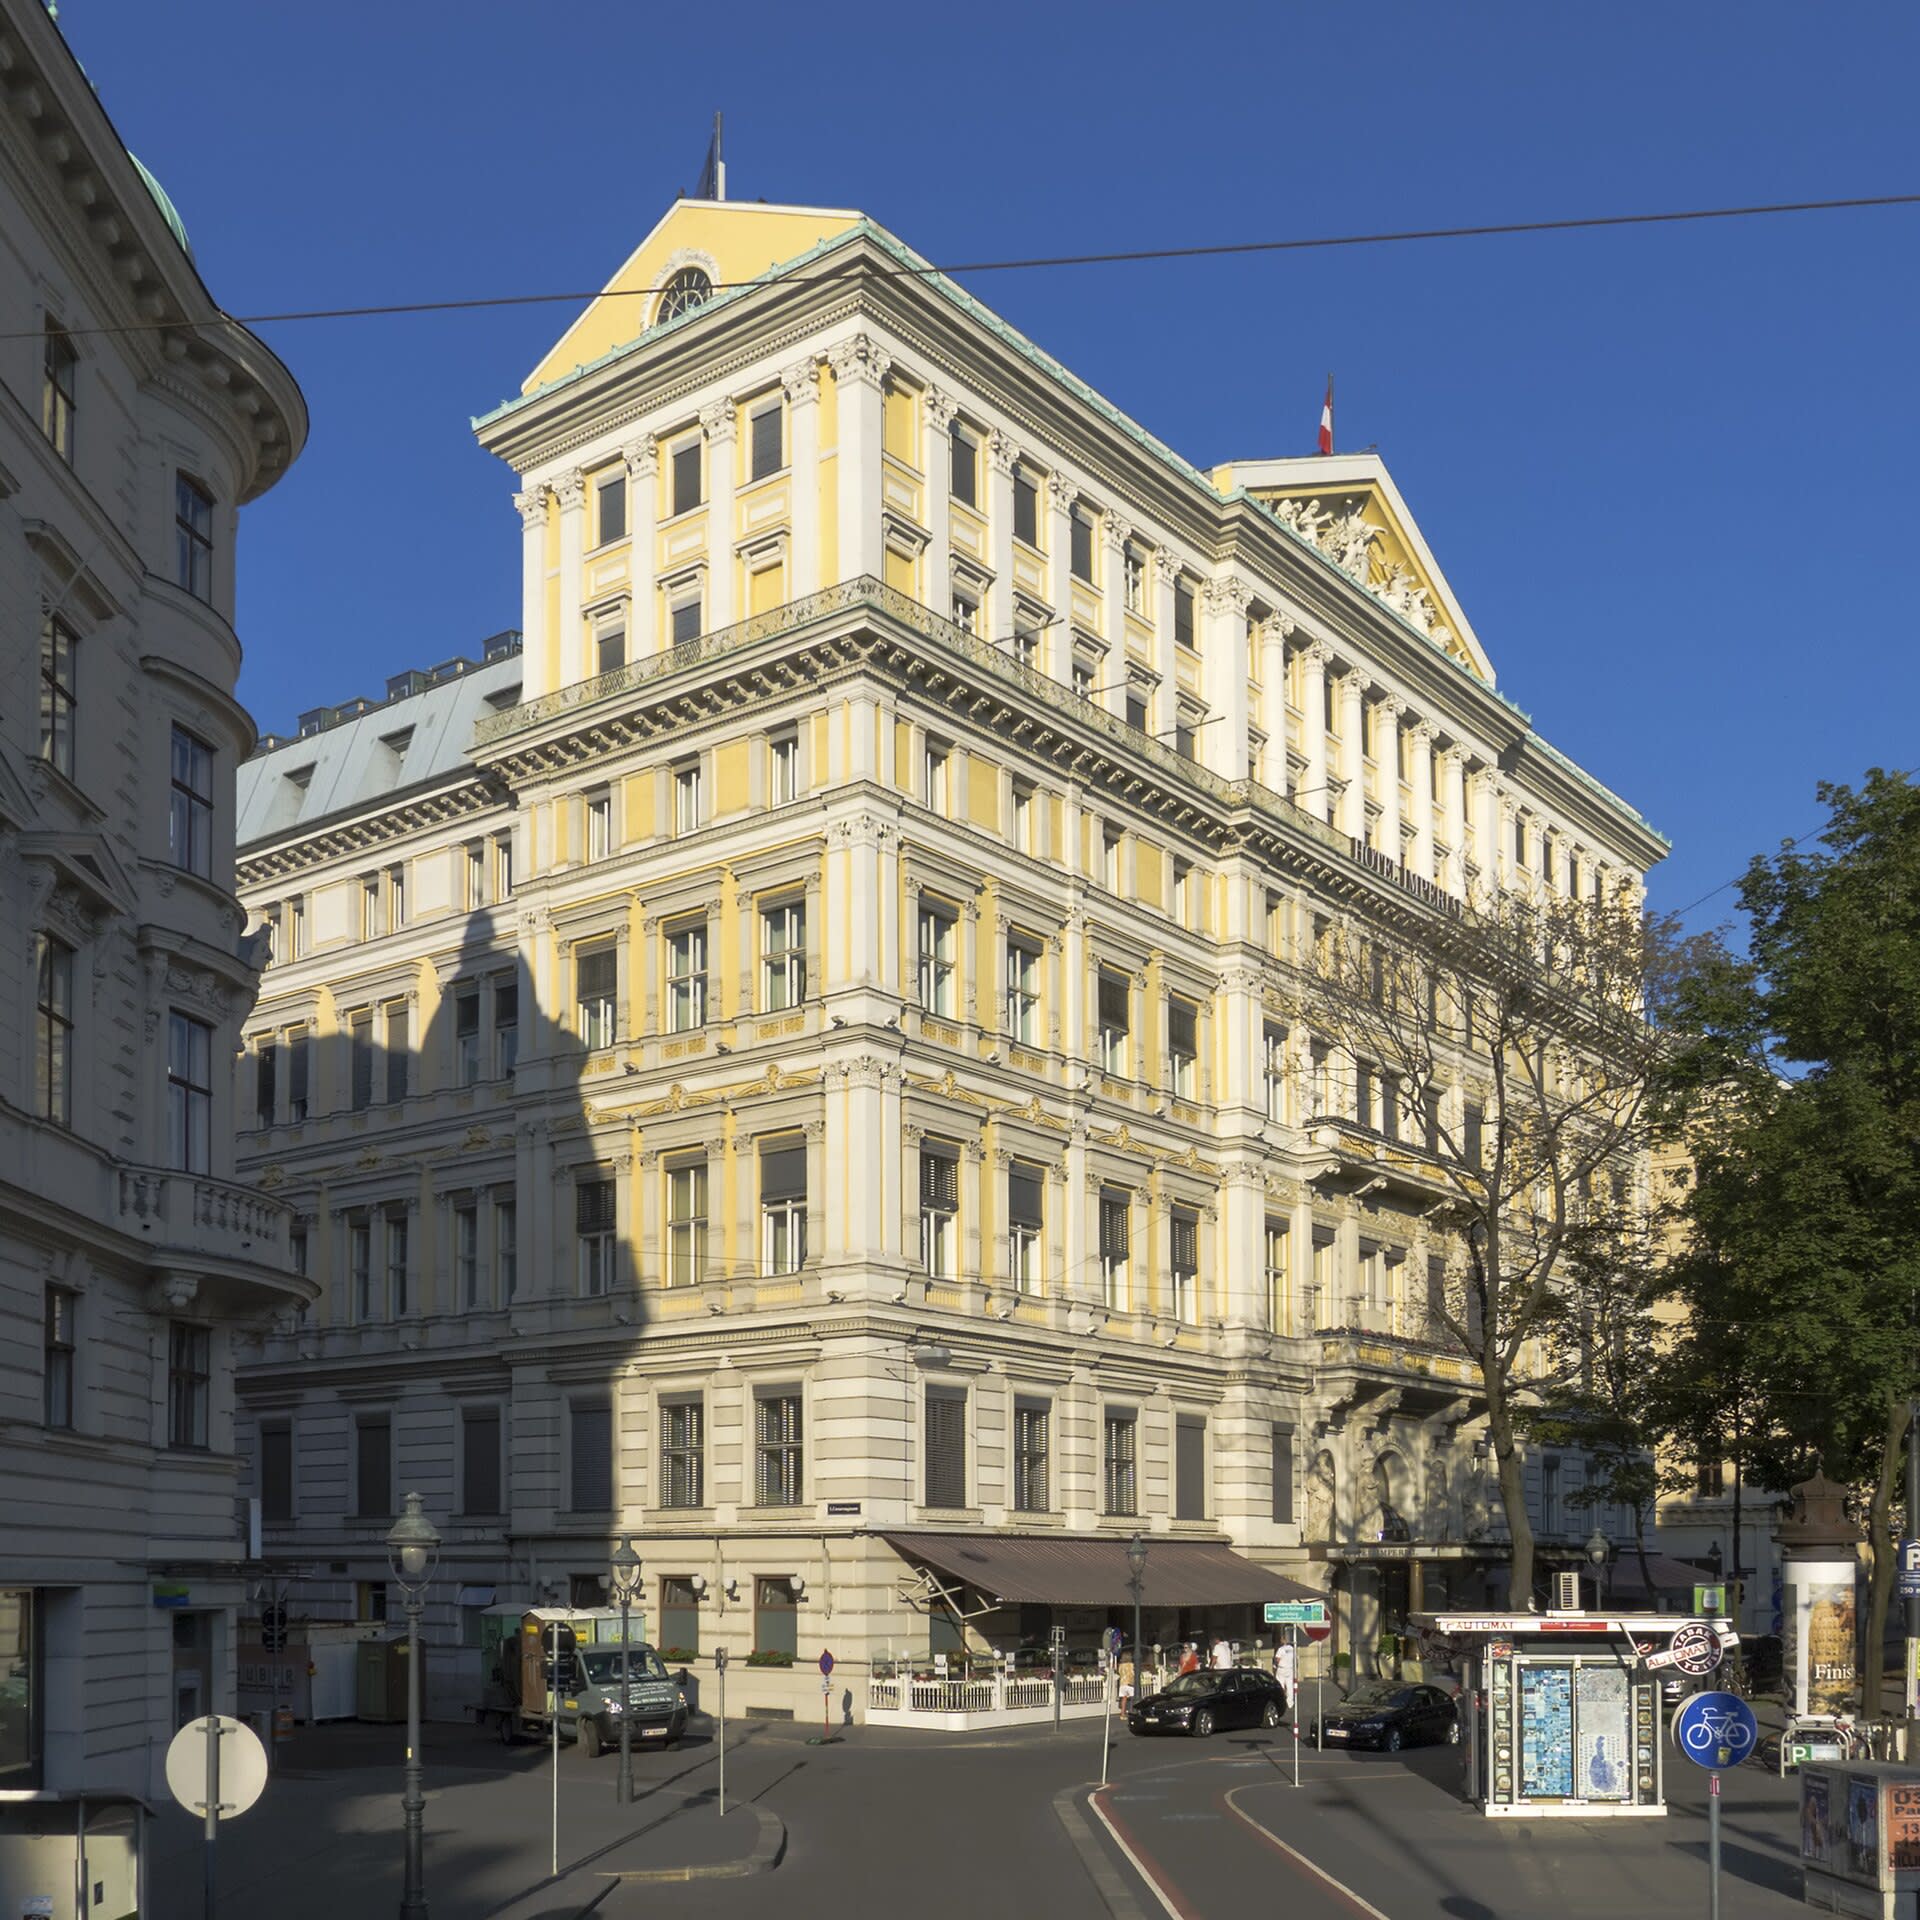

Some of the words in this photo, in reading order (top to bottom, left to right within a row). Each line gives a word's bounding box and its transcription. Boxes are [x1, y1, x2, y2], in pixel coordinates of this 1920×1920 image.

[1354, 838, 1400, 883] HOTEL
[1403, 866, 1463, 919] IMPERIAL
[1675, 1627, 1713, 1648] TABAK
[1647, 1642, 1710, 1669] AUTOMAT
[1792, 1746, 1807, 1763] P
